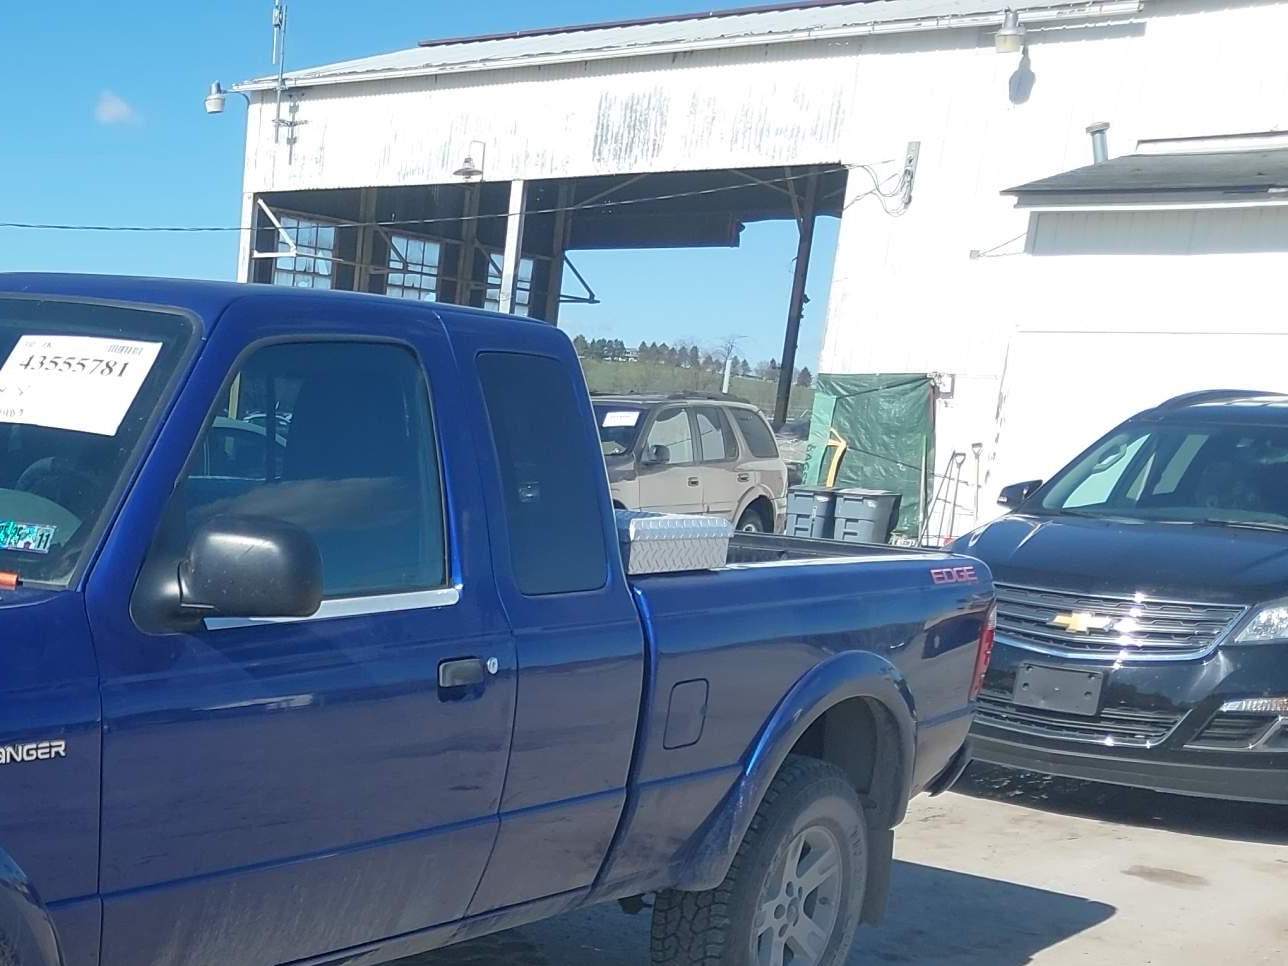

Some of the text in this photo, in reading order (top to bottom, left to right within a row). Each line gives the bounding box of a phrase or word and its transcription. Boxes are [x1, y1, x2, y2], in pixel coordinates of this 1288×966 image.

[19, 354, 130, 377] 43555781
[36, 533, 50, 549] 11
[930, 566, 978, 584] EDGE
